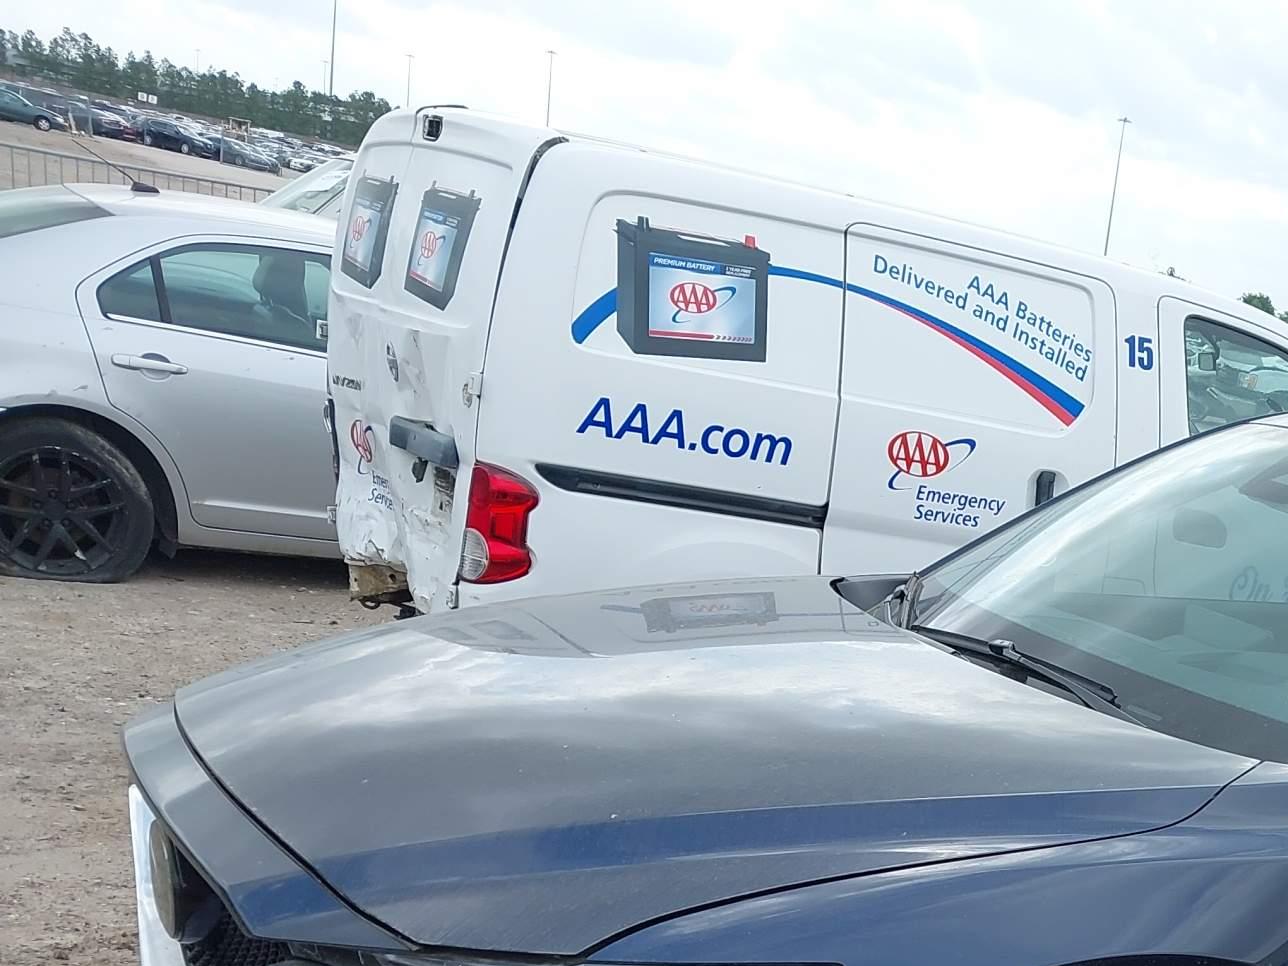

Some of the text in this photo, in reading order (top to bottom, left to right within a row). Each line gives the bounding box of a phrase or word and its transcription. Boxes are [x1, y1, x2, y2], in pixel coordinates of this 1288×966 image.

[653, 256, 686, 269] PREMIUM
[686, 261, 716, 272] BATTERY
[670, 283, 717, 314] AAA
[873, 254, 1089, 382] Delivered and Installed
[967, 275, 1093, 363] AAA Batteries
[1124, 335, 1154, 371] 15
[576, 397, 793, 466] AAA.com
[887, 431, 950, 478] AAA
[914, 504, 980, 528] Services
[916, 485, 1006, 516] Emergency
